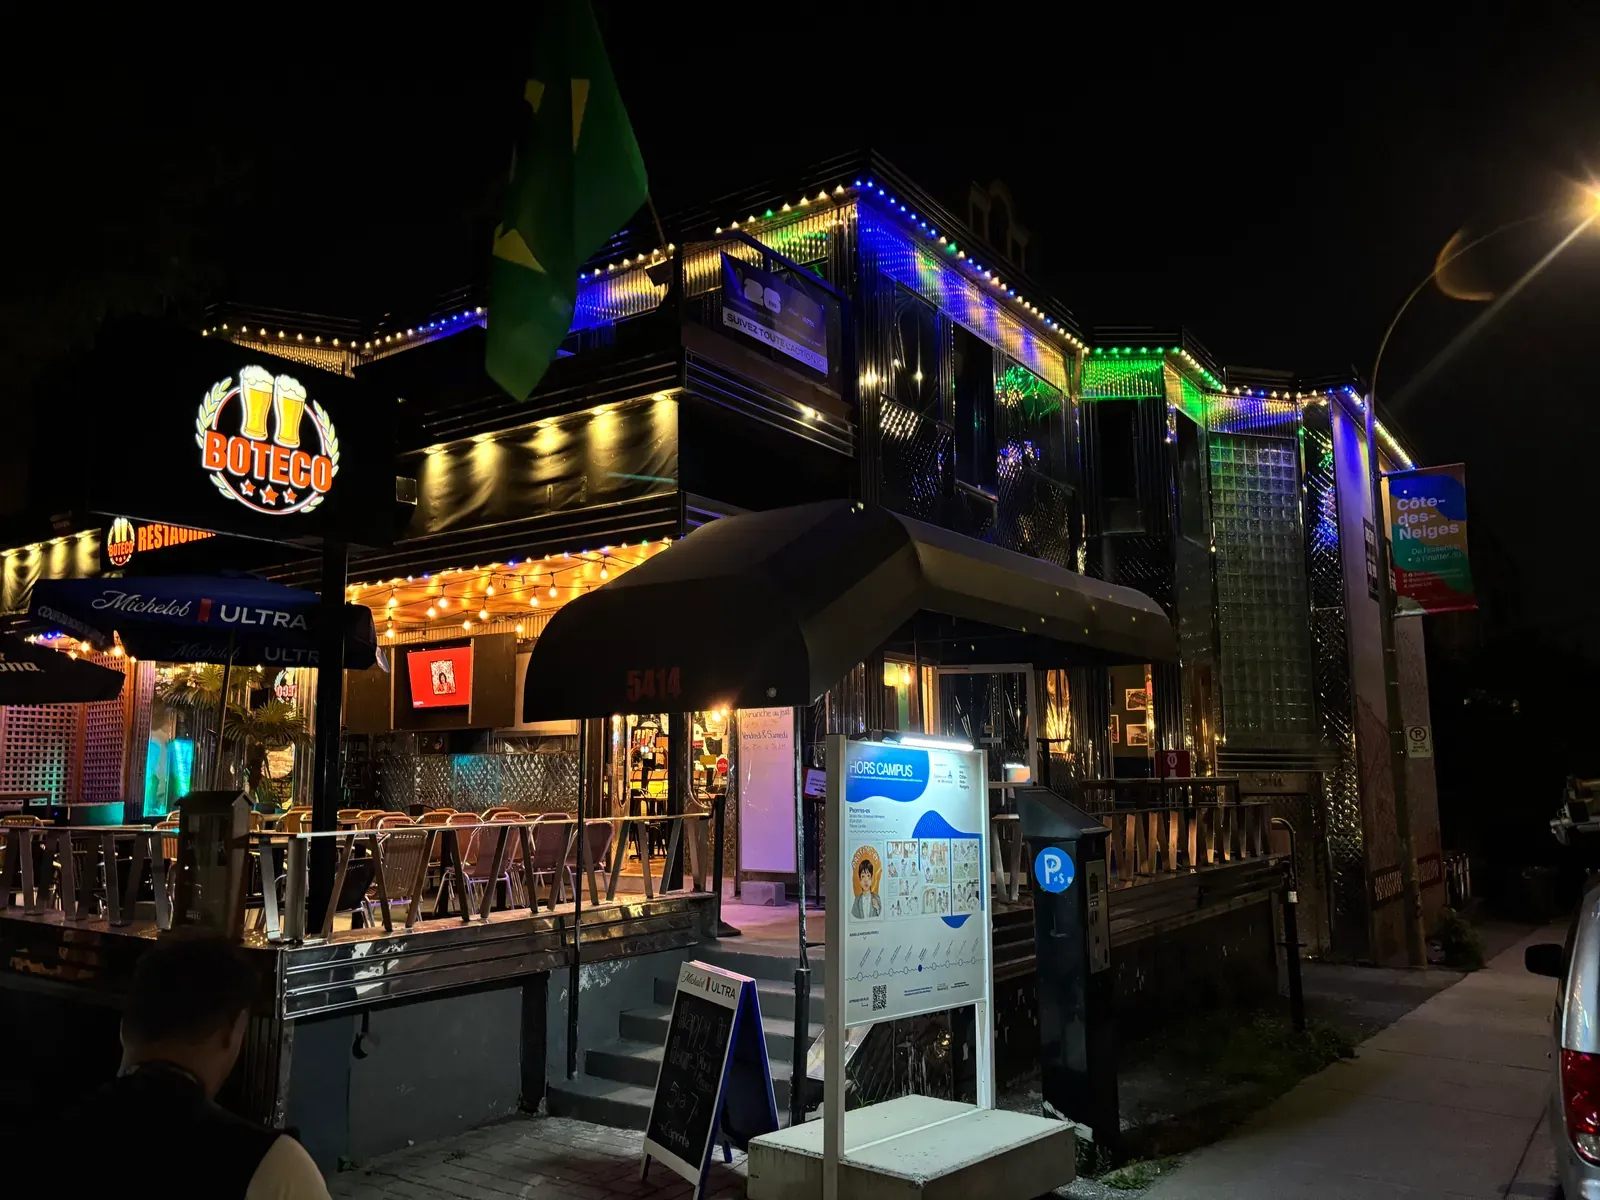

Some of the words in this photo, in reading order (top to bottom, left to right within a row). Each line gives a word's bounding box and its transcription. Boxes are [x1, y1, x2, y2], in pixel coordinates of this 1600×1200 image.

[726, 312, 758, 335] SUIVEZ
[758, 328, 786, 349] TOUTE
[202, 429, 333, 493] BOTECO
[1396, 495, 1446, 511] Côte-
[1397, 511, 1437, 526] des-
[138, 524, 216, 552] RESTAU
[1399, 523, 1460, 541] Neiges
[108, 540, 134, 557] BOTECO
[91, 589, 193, 617] Michelob
[219, 603, 309, 631] ULTRA
[263, 645, 320, 664] ULTR
[626, 666, 681, 702] 5414
[767, 730, 788, 740] Samedi
[849, 760, 876, 775] HORS
[876, 762, 913, 777] CAMPUS
[711, 980, 737, 1000] ULTRA
